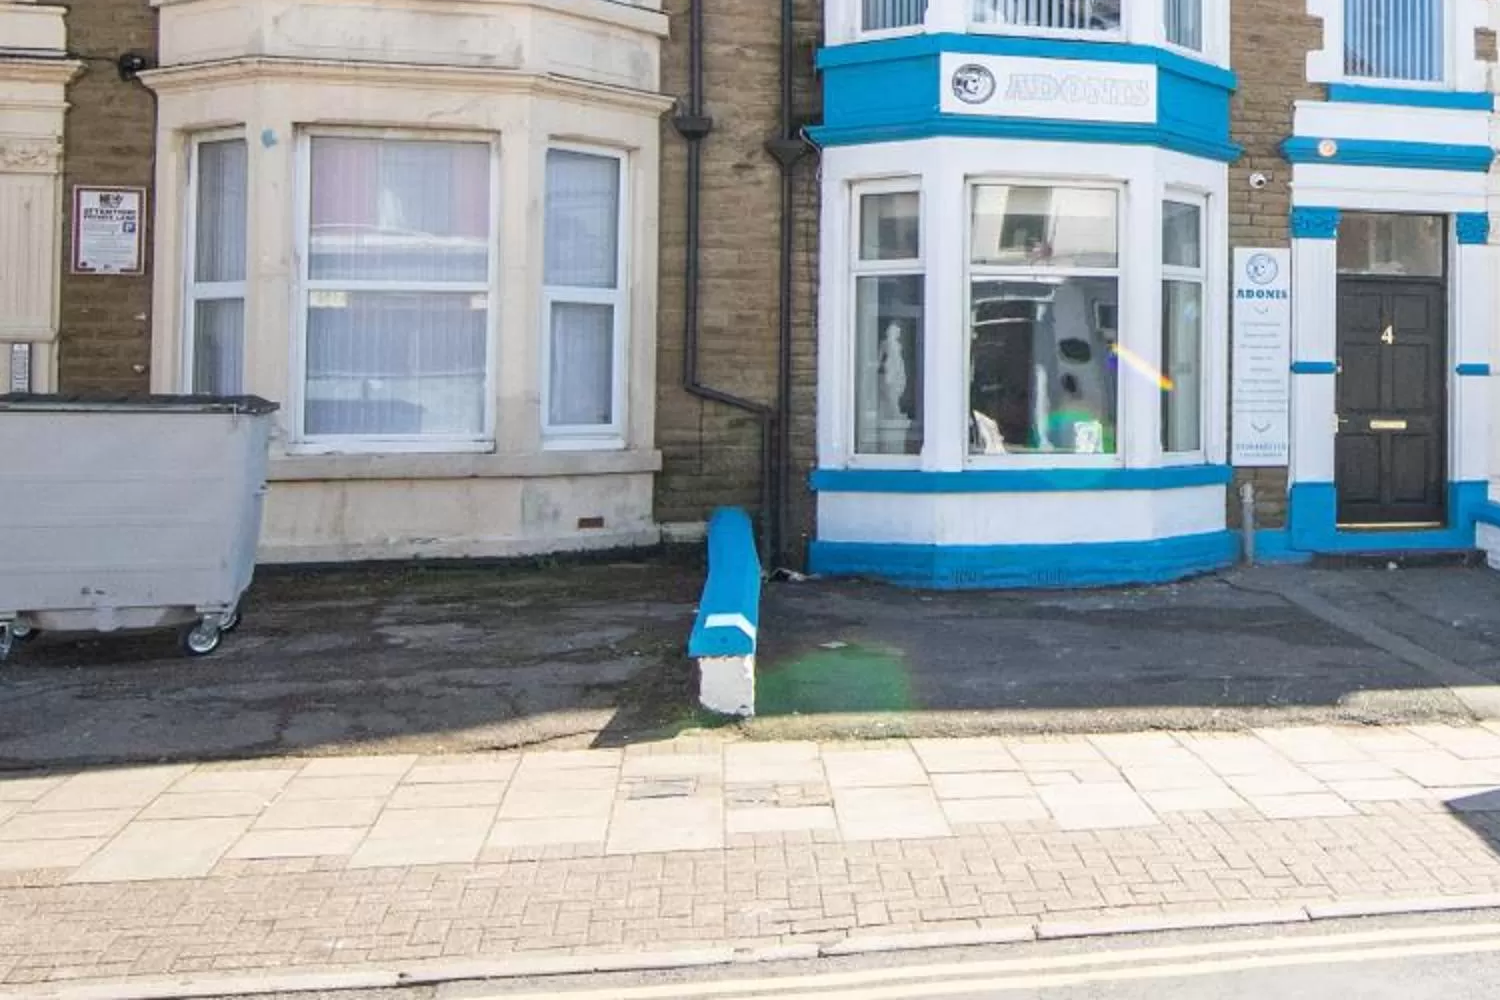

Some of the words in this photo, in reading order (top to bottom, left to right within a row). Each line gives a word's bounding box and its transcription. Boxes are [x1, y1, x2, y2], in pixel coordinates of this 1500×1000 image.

[1004, 73, 1149, 106] ADONIS
[1236, 289, 1288, 300] ADONIS
[1380, 325, 1395, 345] 4
